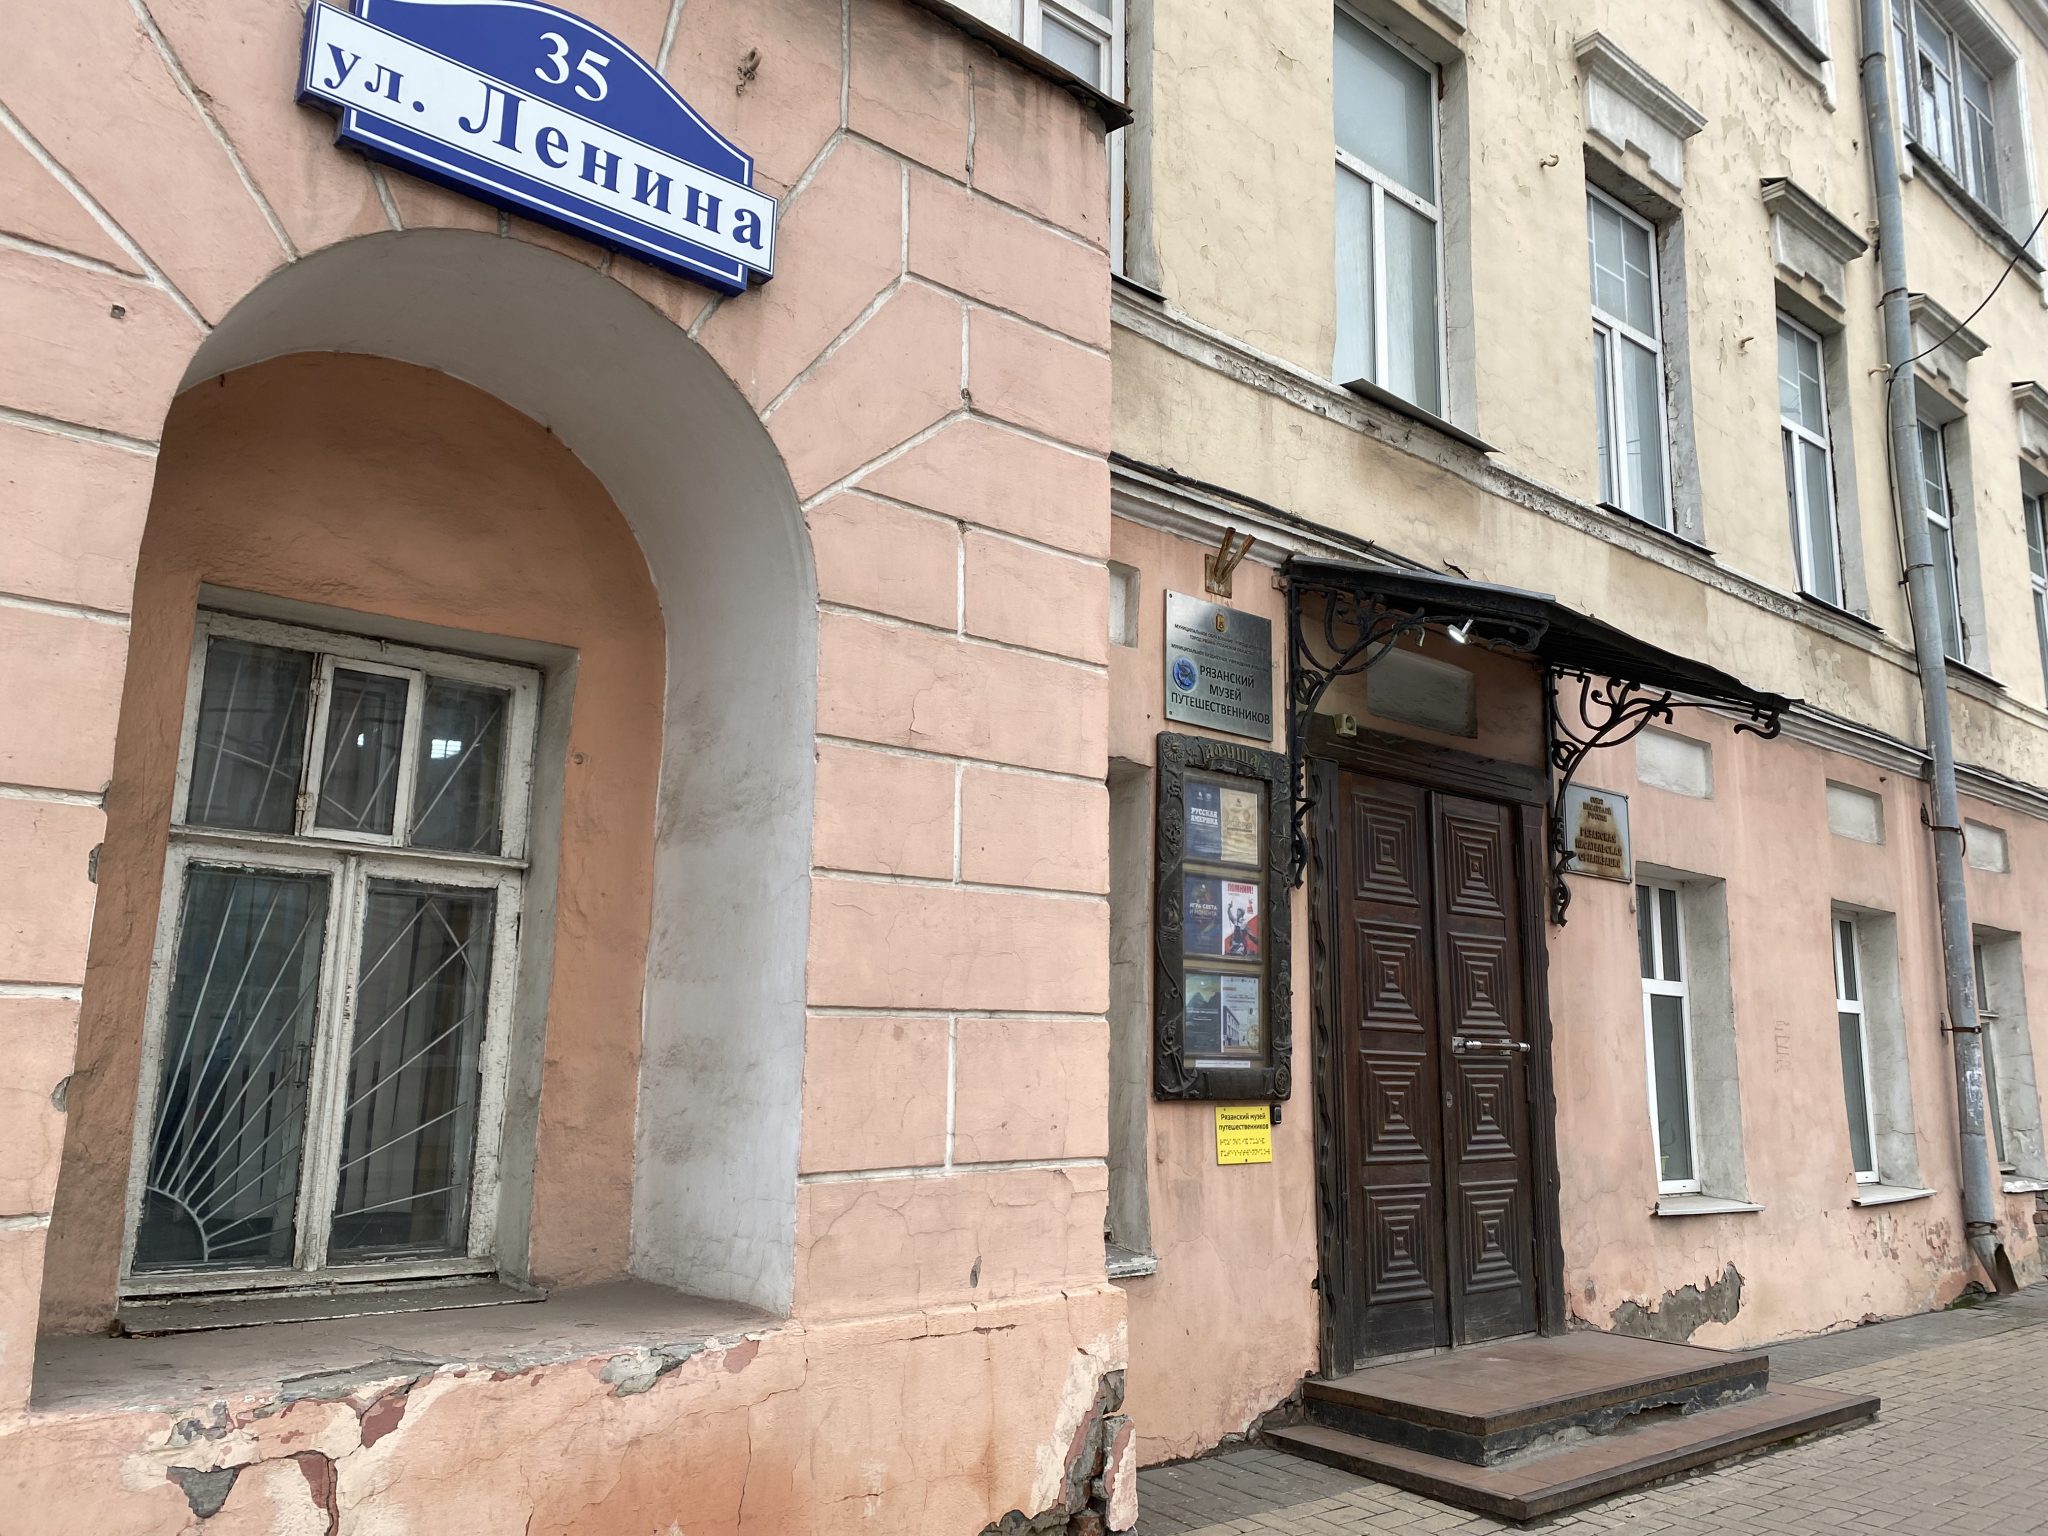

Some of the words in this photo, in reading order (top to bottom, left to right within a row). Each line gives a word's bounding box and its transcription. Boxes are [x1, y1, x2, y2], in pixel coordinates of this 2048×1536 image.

[534, 31, 610, 102] 35
[323, 42, 425, 113] ул.
[458, 80, 764, 250] Ленина
[1200, 665, 1255, 689] РЯЗАНСКИЙ
[1209, 684, 1242, 701] МУЗЕЙ
[1171, 692, 1270, 725] ПУТЕШЕСТВЕННИКОВ
[1191, 807, 1218, 818] РУССКАЯ
[1191, 815, 1219, 826] АМЕРИКА
[1220, 1112, 1250, 1121] Рязанский
[1250, 1112, 1266, 1121] музей
[1218, 1123, 1269, 1132] путешественников
